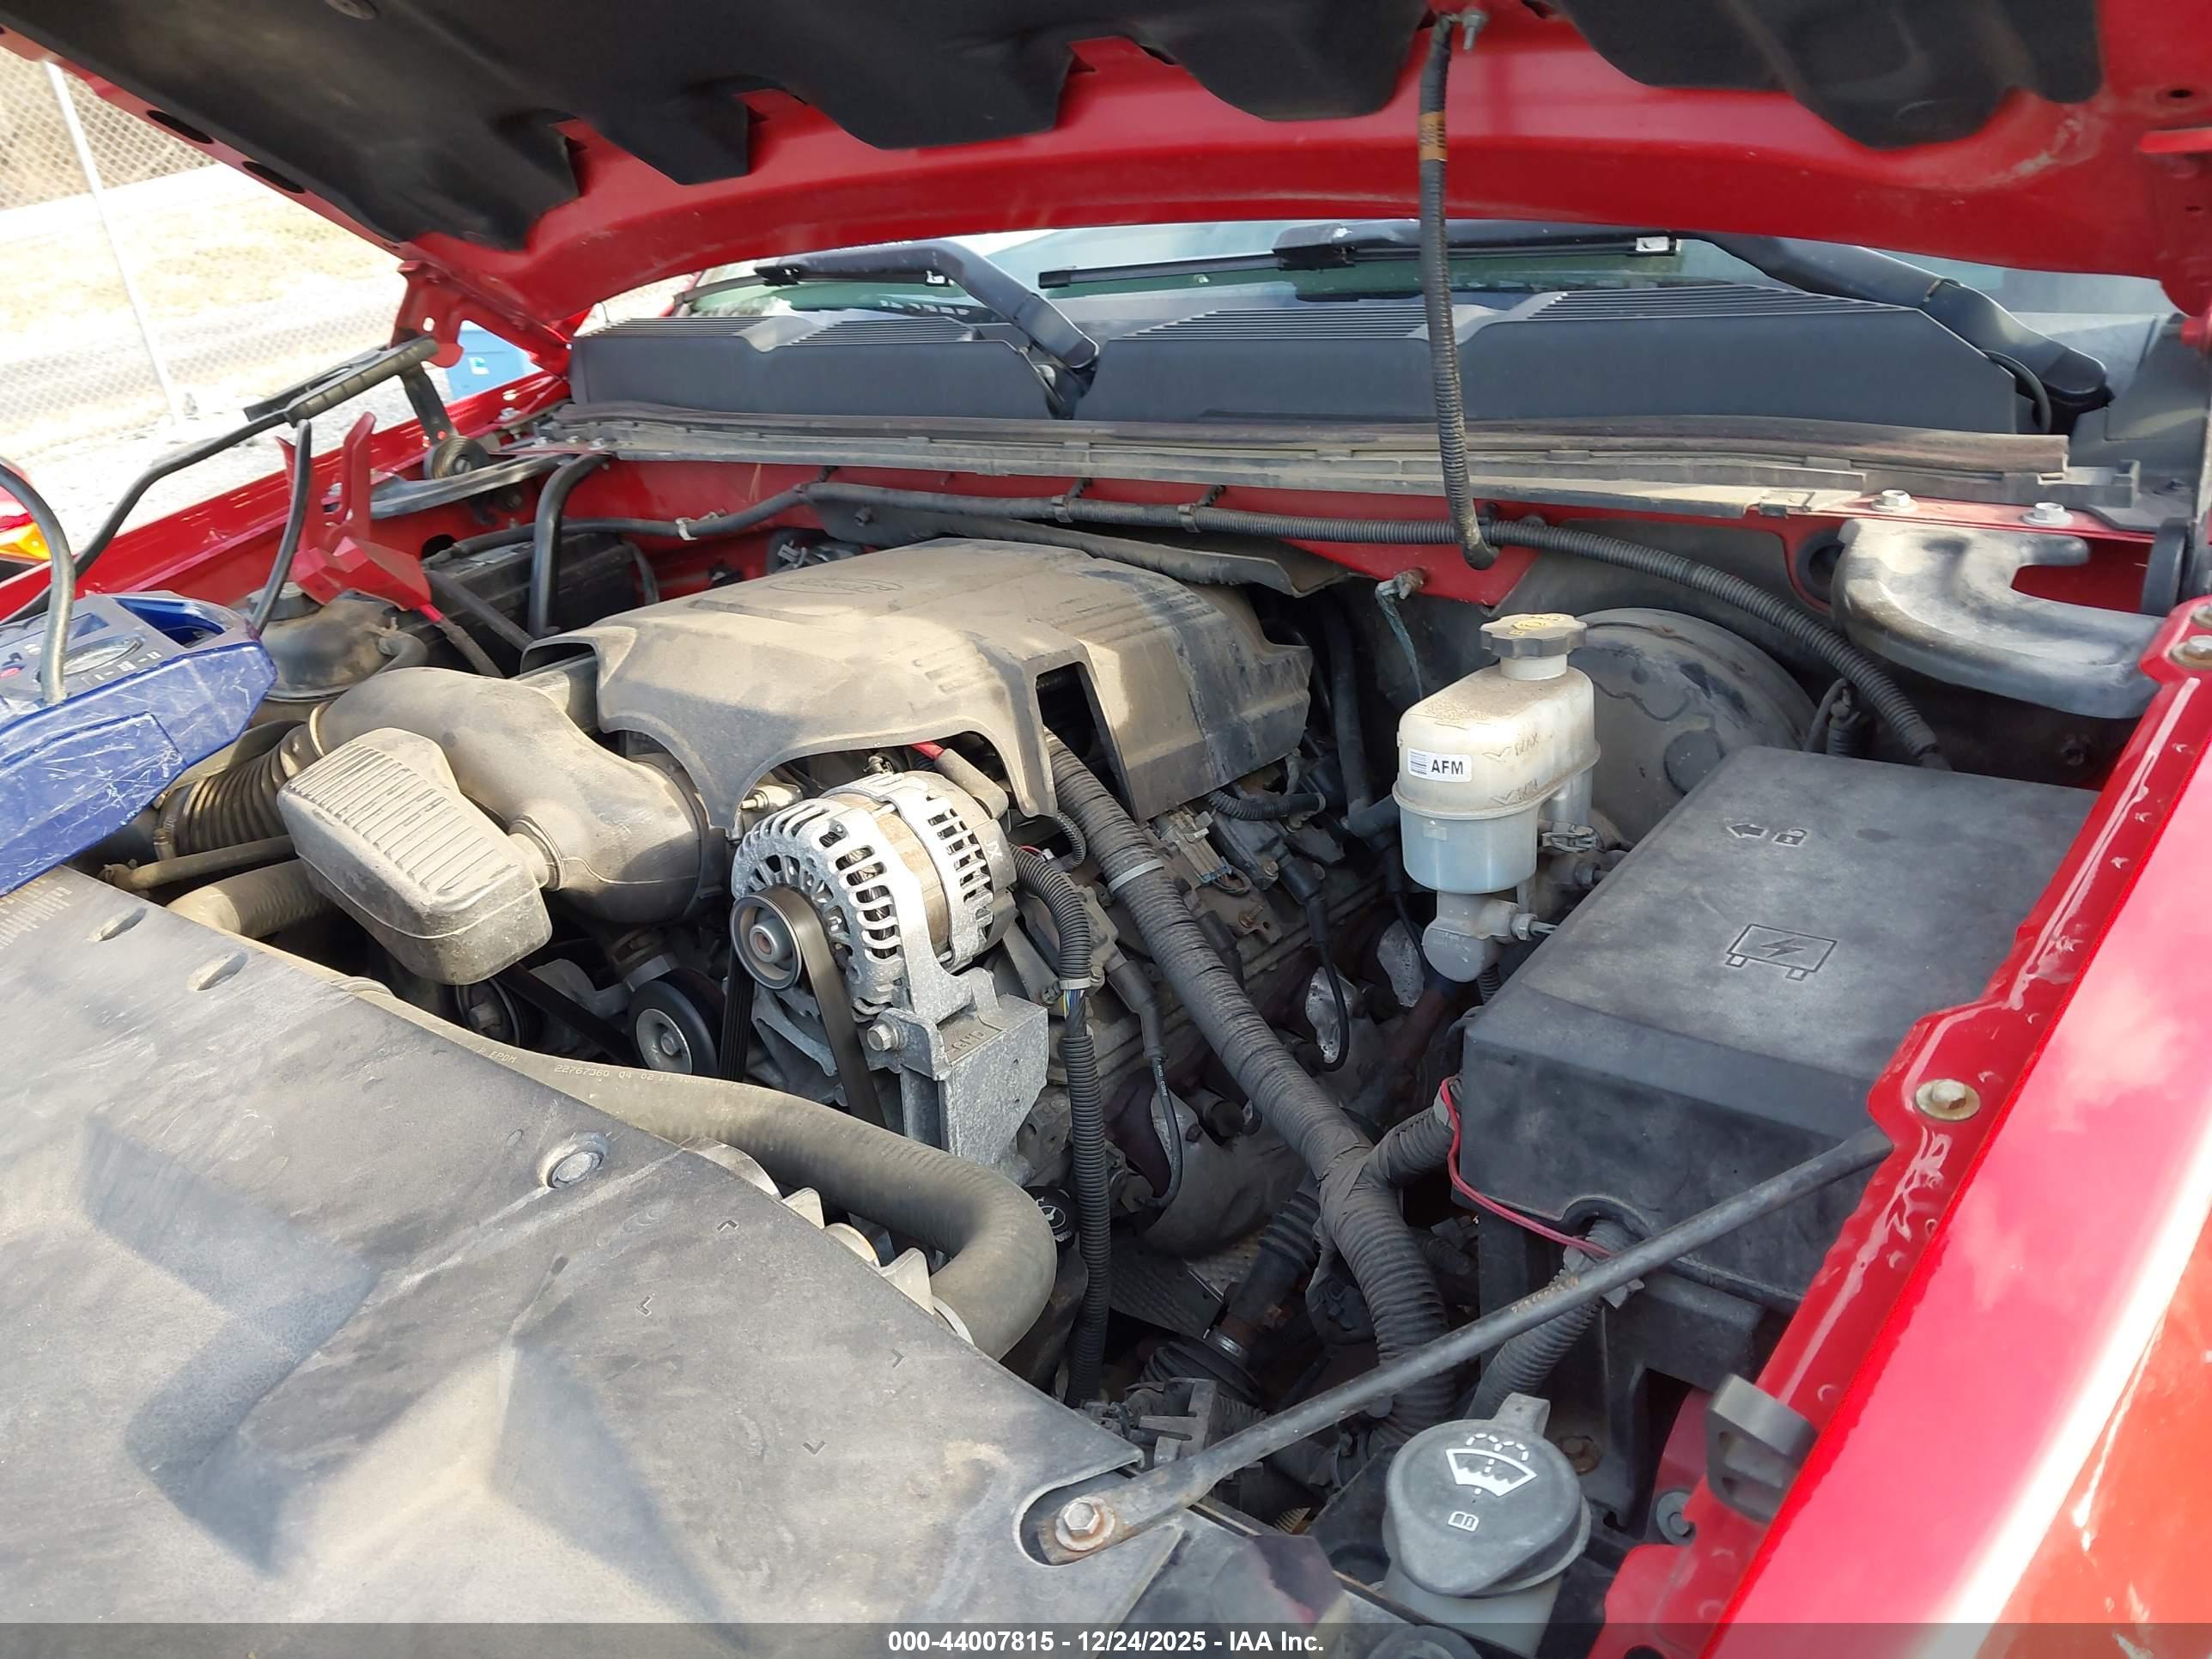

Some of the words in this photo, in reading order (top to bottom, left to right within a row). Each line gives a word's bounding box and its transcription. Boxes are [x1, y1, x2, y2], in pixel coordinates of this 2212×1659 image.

[1431, 759, 1463, 775] AFM
[554, 1064, 611, 1078] 22767360
[618, 1071, 633, 1080] 04
